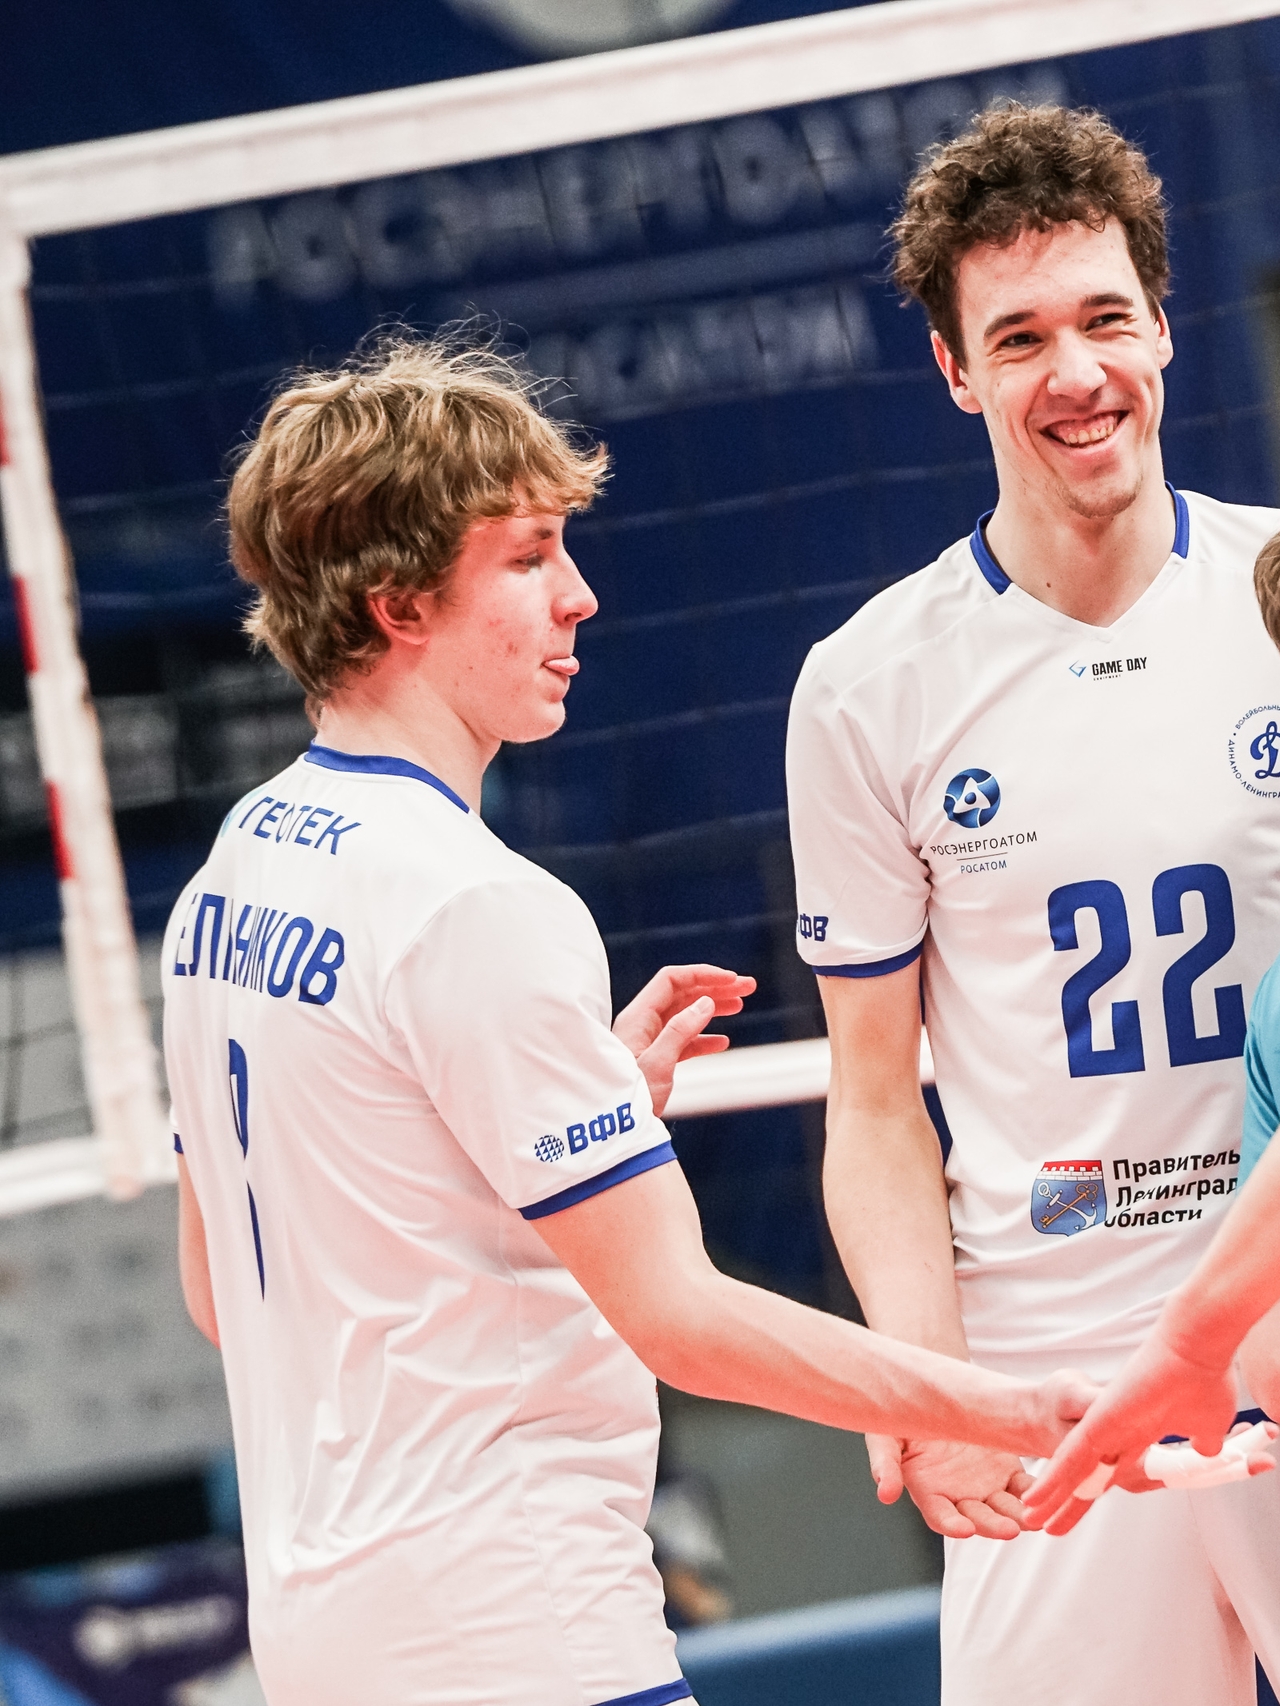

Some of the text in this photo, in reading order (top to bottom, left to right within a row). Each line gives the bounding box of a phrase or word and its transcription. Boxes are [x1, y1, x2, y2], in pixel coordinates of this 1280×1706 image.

[1091, 656, 1147, 676] GAME DAY
[238, 796, 362, 856] ГЕОТЕК
[930, 831, 1038, 856] РОСЭНЕРГОАТОМ
[960, 859, 1008, 874] РОСАТОМ
[797, 913, 829, 942] ФВ
[1047, 863, 1247, 1078] 22
[567, 1102, 636, 1156] ВФВ
